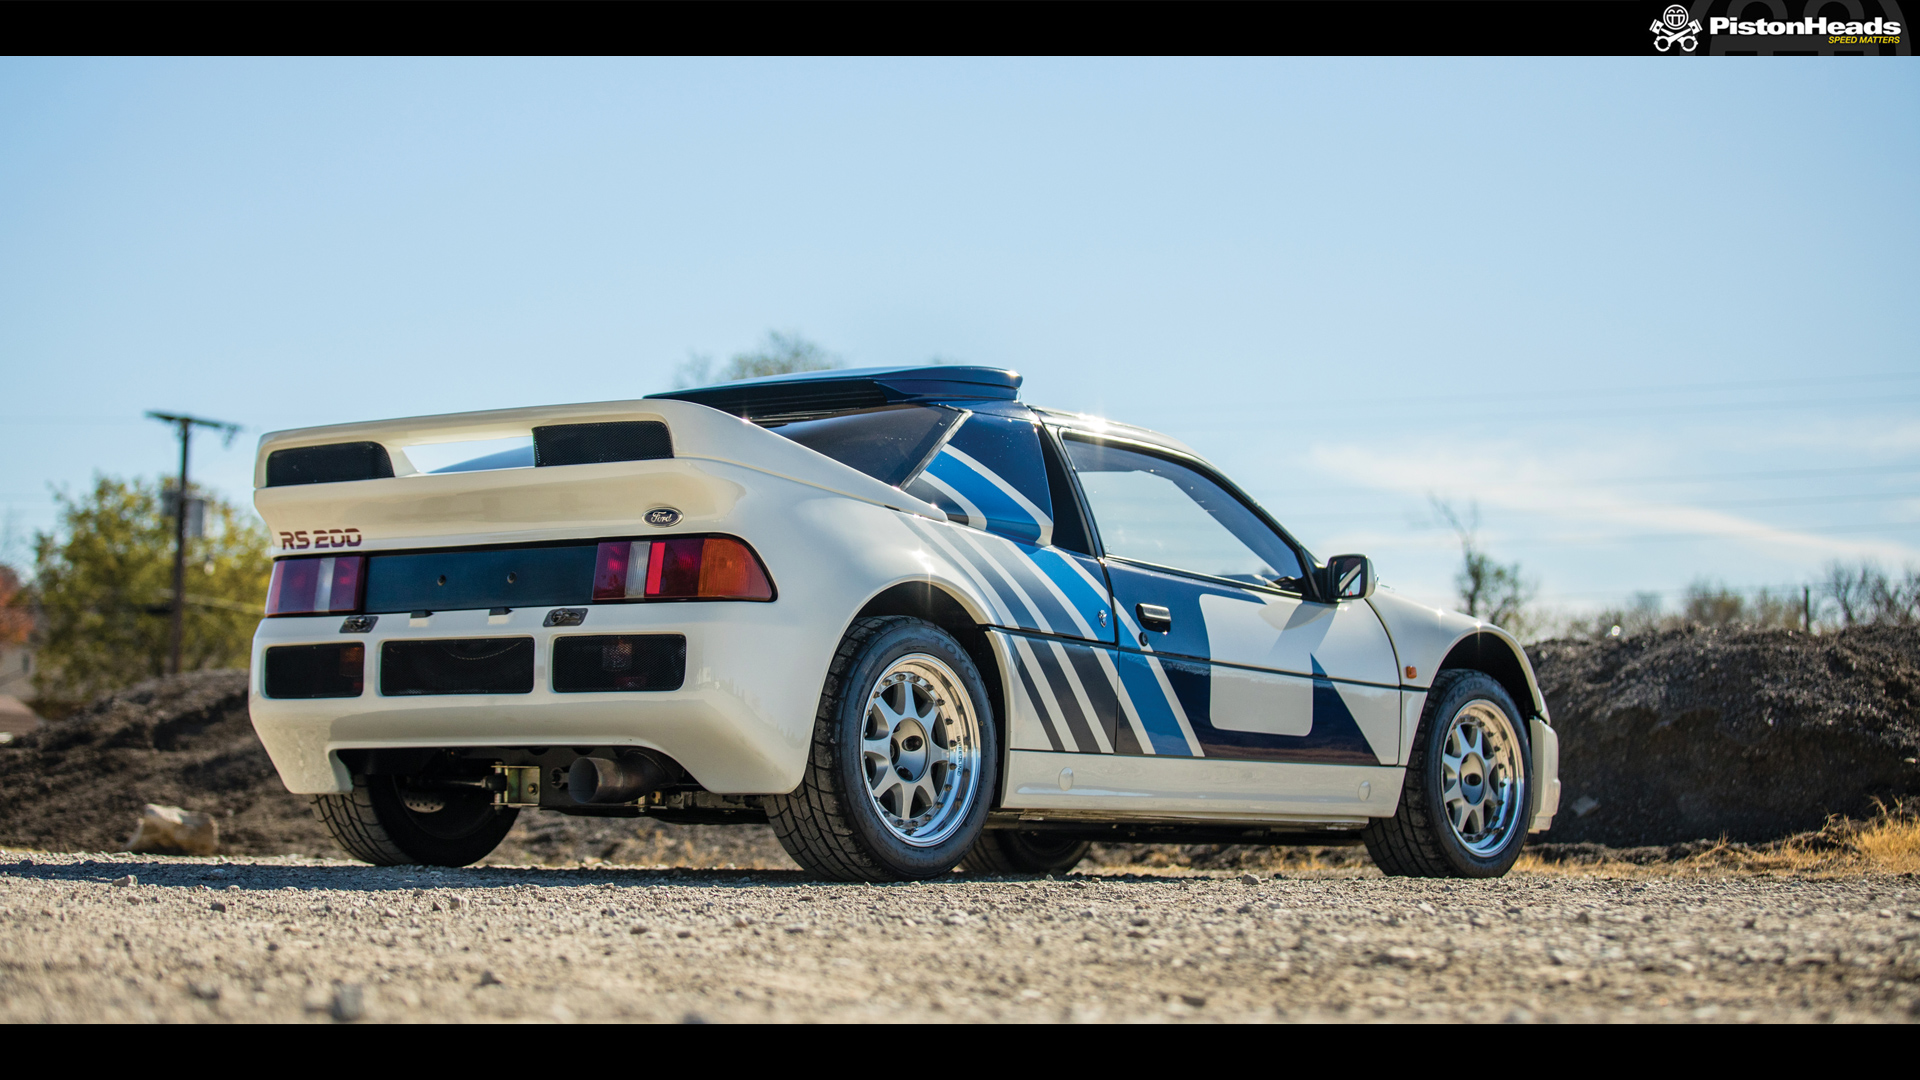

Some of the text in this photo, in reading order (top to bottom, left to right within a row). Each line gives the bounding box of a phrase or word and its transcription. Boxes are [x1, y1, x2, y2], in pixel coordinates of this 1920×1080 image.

[650, 511, 673, 523] Ford
[279, 527, 362, 550] RS 200
[932, 634, 977, 681] TOYO
